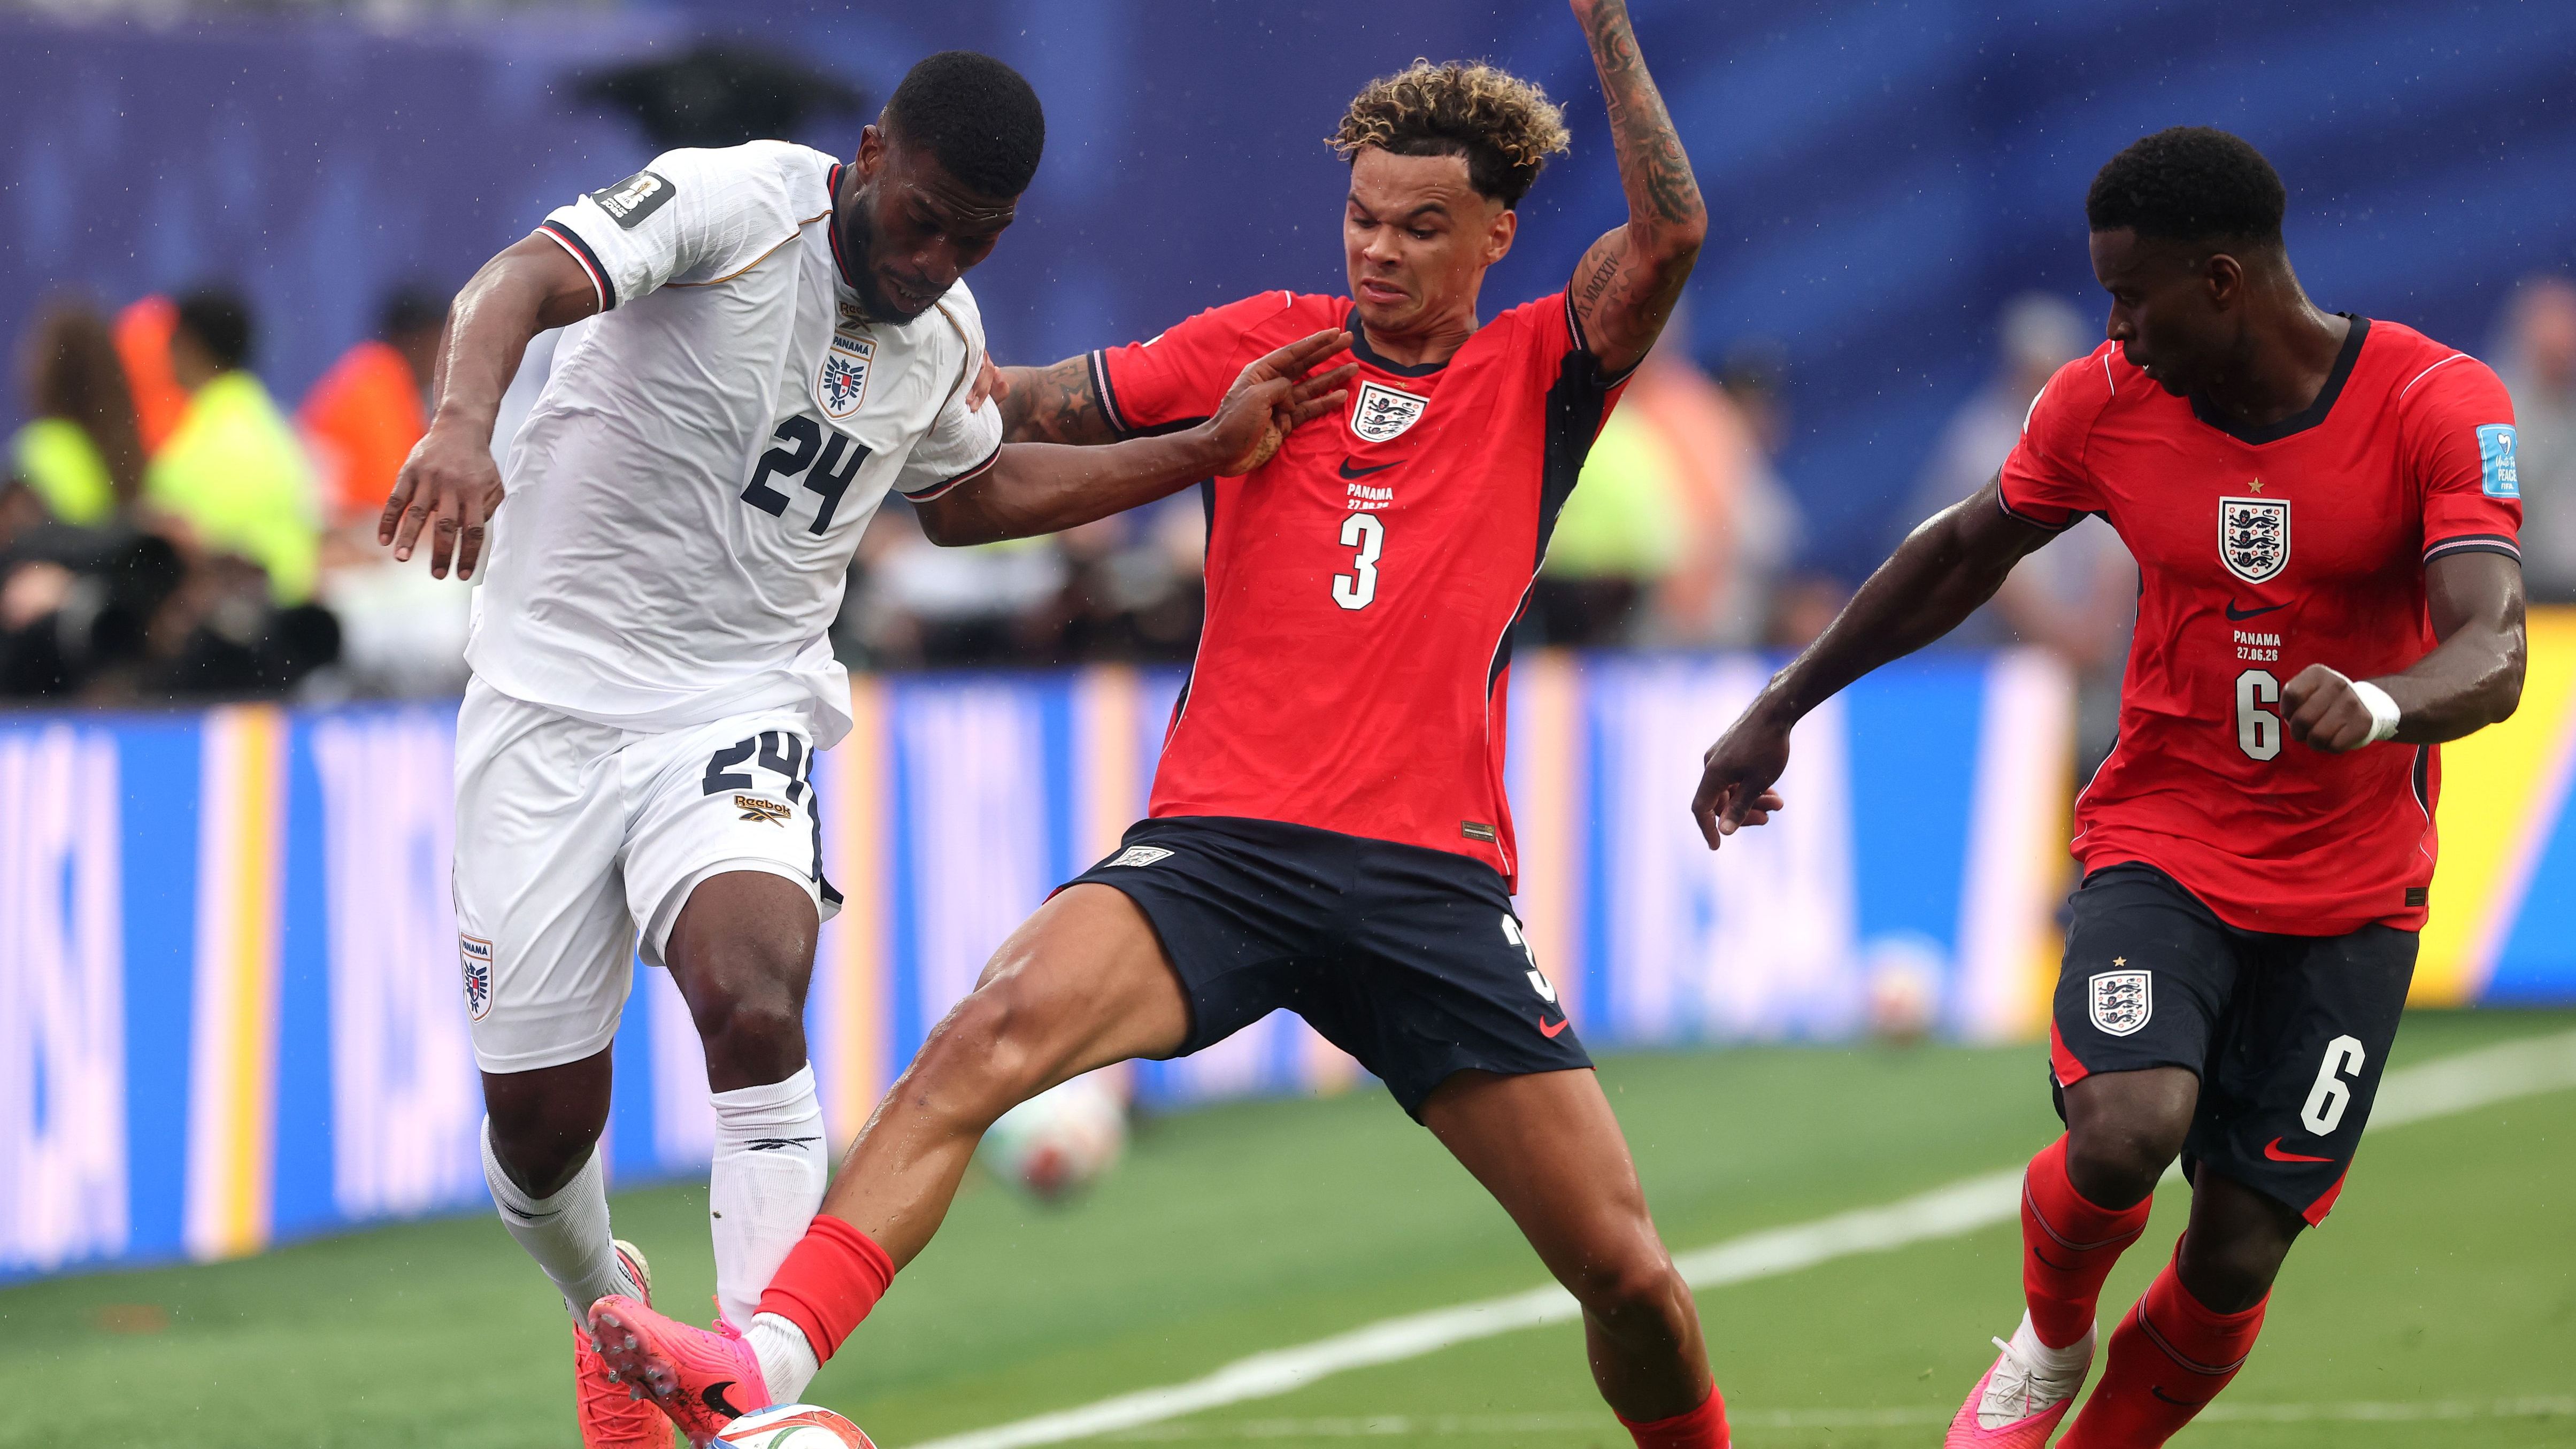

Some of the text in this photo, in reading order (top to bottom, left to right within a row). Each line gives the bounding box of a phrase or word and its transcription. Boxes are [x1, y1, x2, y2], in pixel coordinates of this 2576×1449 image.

[600, 200, 624, 218] 2026
[833, 336, 869, 356] PANAMÁ
[740, 414, 873, 536] 24
[2498, 469, 2517, 482] PEACE
[1347, 483, 1394, 500] PANAMA
[1332, 512, 1385, 610] 3
[2234, 630, 2281, 646] PANAMA
[2237, 646, 2278, 661] 27.06.26
[2235, 668, 2282, 761] 6
[702, 730, 804, 806] 24
[734, 795, 791, 817] Reebok
[463, 939, 488, 956] PANAMÁ
[1500, 912, 1557, 1004] 3
[2300, 1034, 2366, 1137] 6
